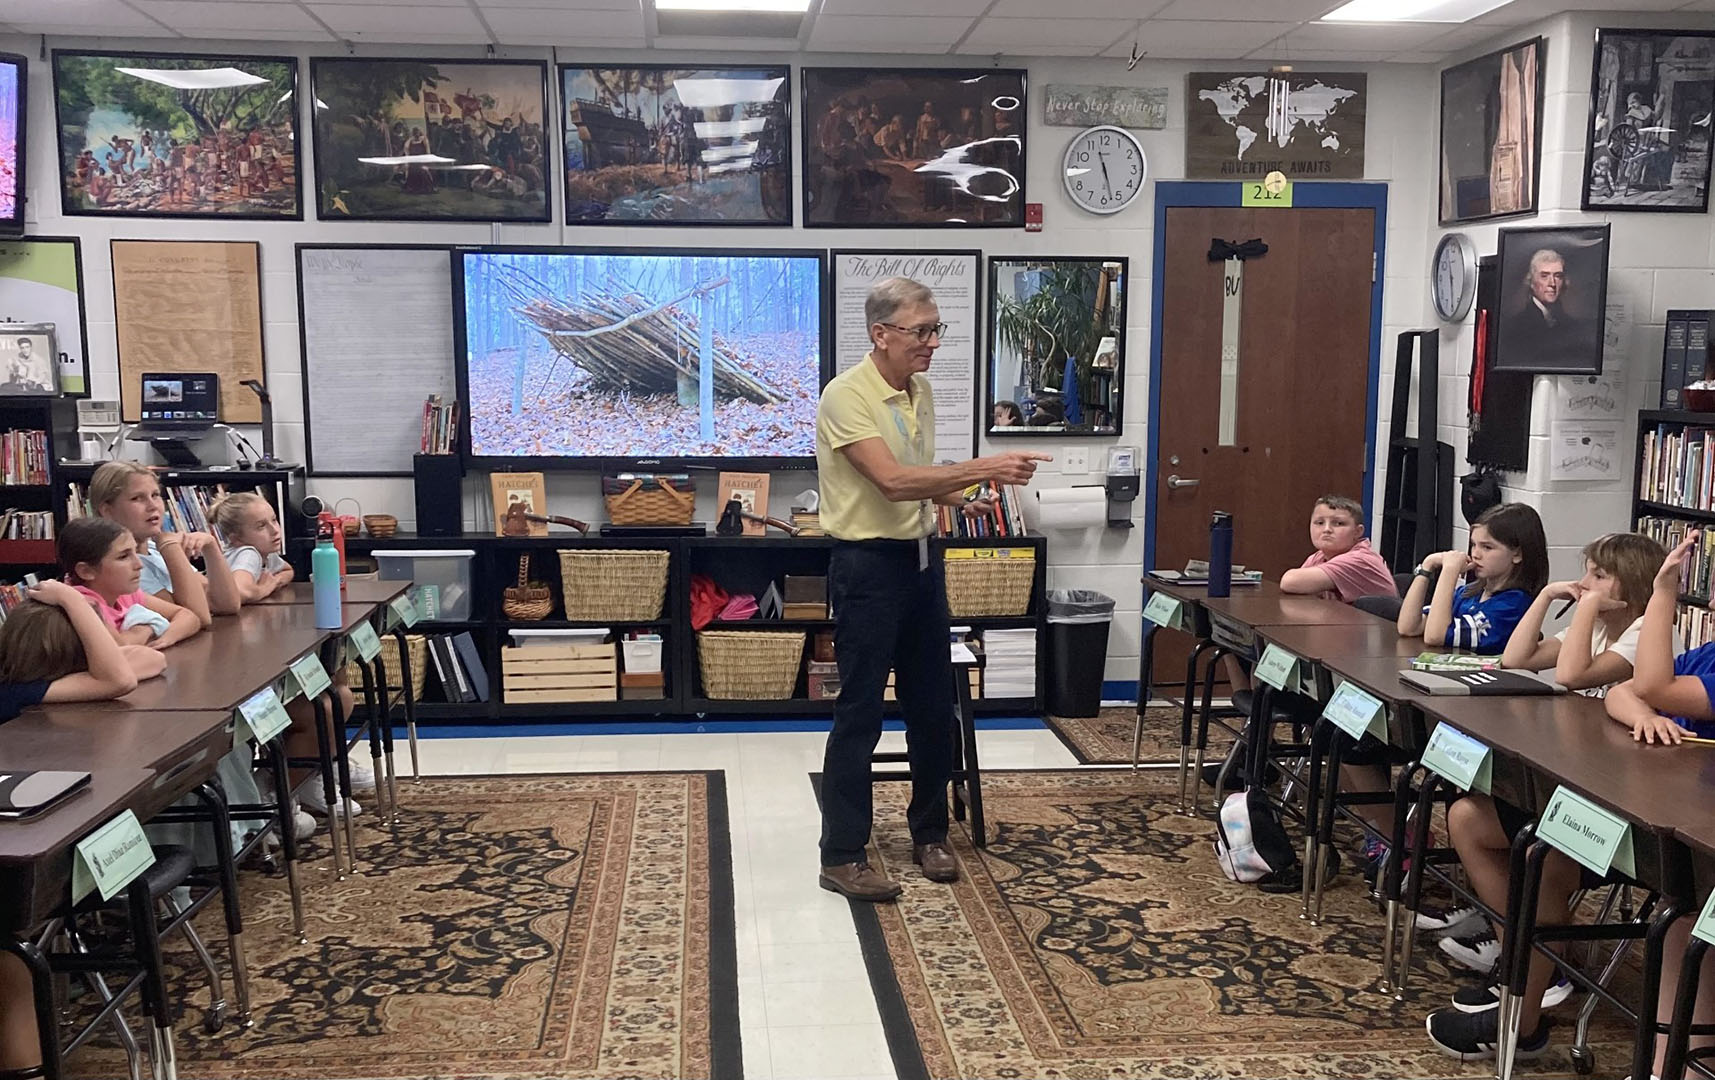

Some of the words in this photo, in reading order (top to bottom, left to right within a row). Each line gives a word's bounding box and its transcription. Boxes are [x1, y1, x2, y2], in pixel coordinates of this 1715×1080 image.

[1046, 95, 1081, 113] Never
[1083, 96, 1109, 116] Stop
[1112, 98, 1166, 119] Exploring
[1087, 140, 1095, 151] 11
[1100, 135, 1110, 146] 12
[1077, 151, 1090, 162] 10
[1126, 149, 1133, 160] 2
[1130, 164, 1137, 175] 3
[1221, 161, 1283, 174] ADVENTURE
[1290, 161, 1331, 174] AWAITS
[1075, 180, 1083, 191] 8
[1126, 179, 1133, 189] 4
[1087, 190, 1094, 201] 7
[1100, 195, 1108, 205] 6
[1115, 190, 1122, 201] 5
[844, 256, 873, 277] The
[873, 258, 902, 280] Bill
[903, 258, 925, 281] Of
[924, 258, 967, 286] Rights
[724, 479, 763, 489] HATCHET
[1562, 814, 1582, 832] Elaina
[1582, 825, 1606, 846] Morrow
